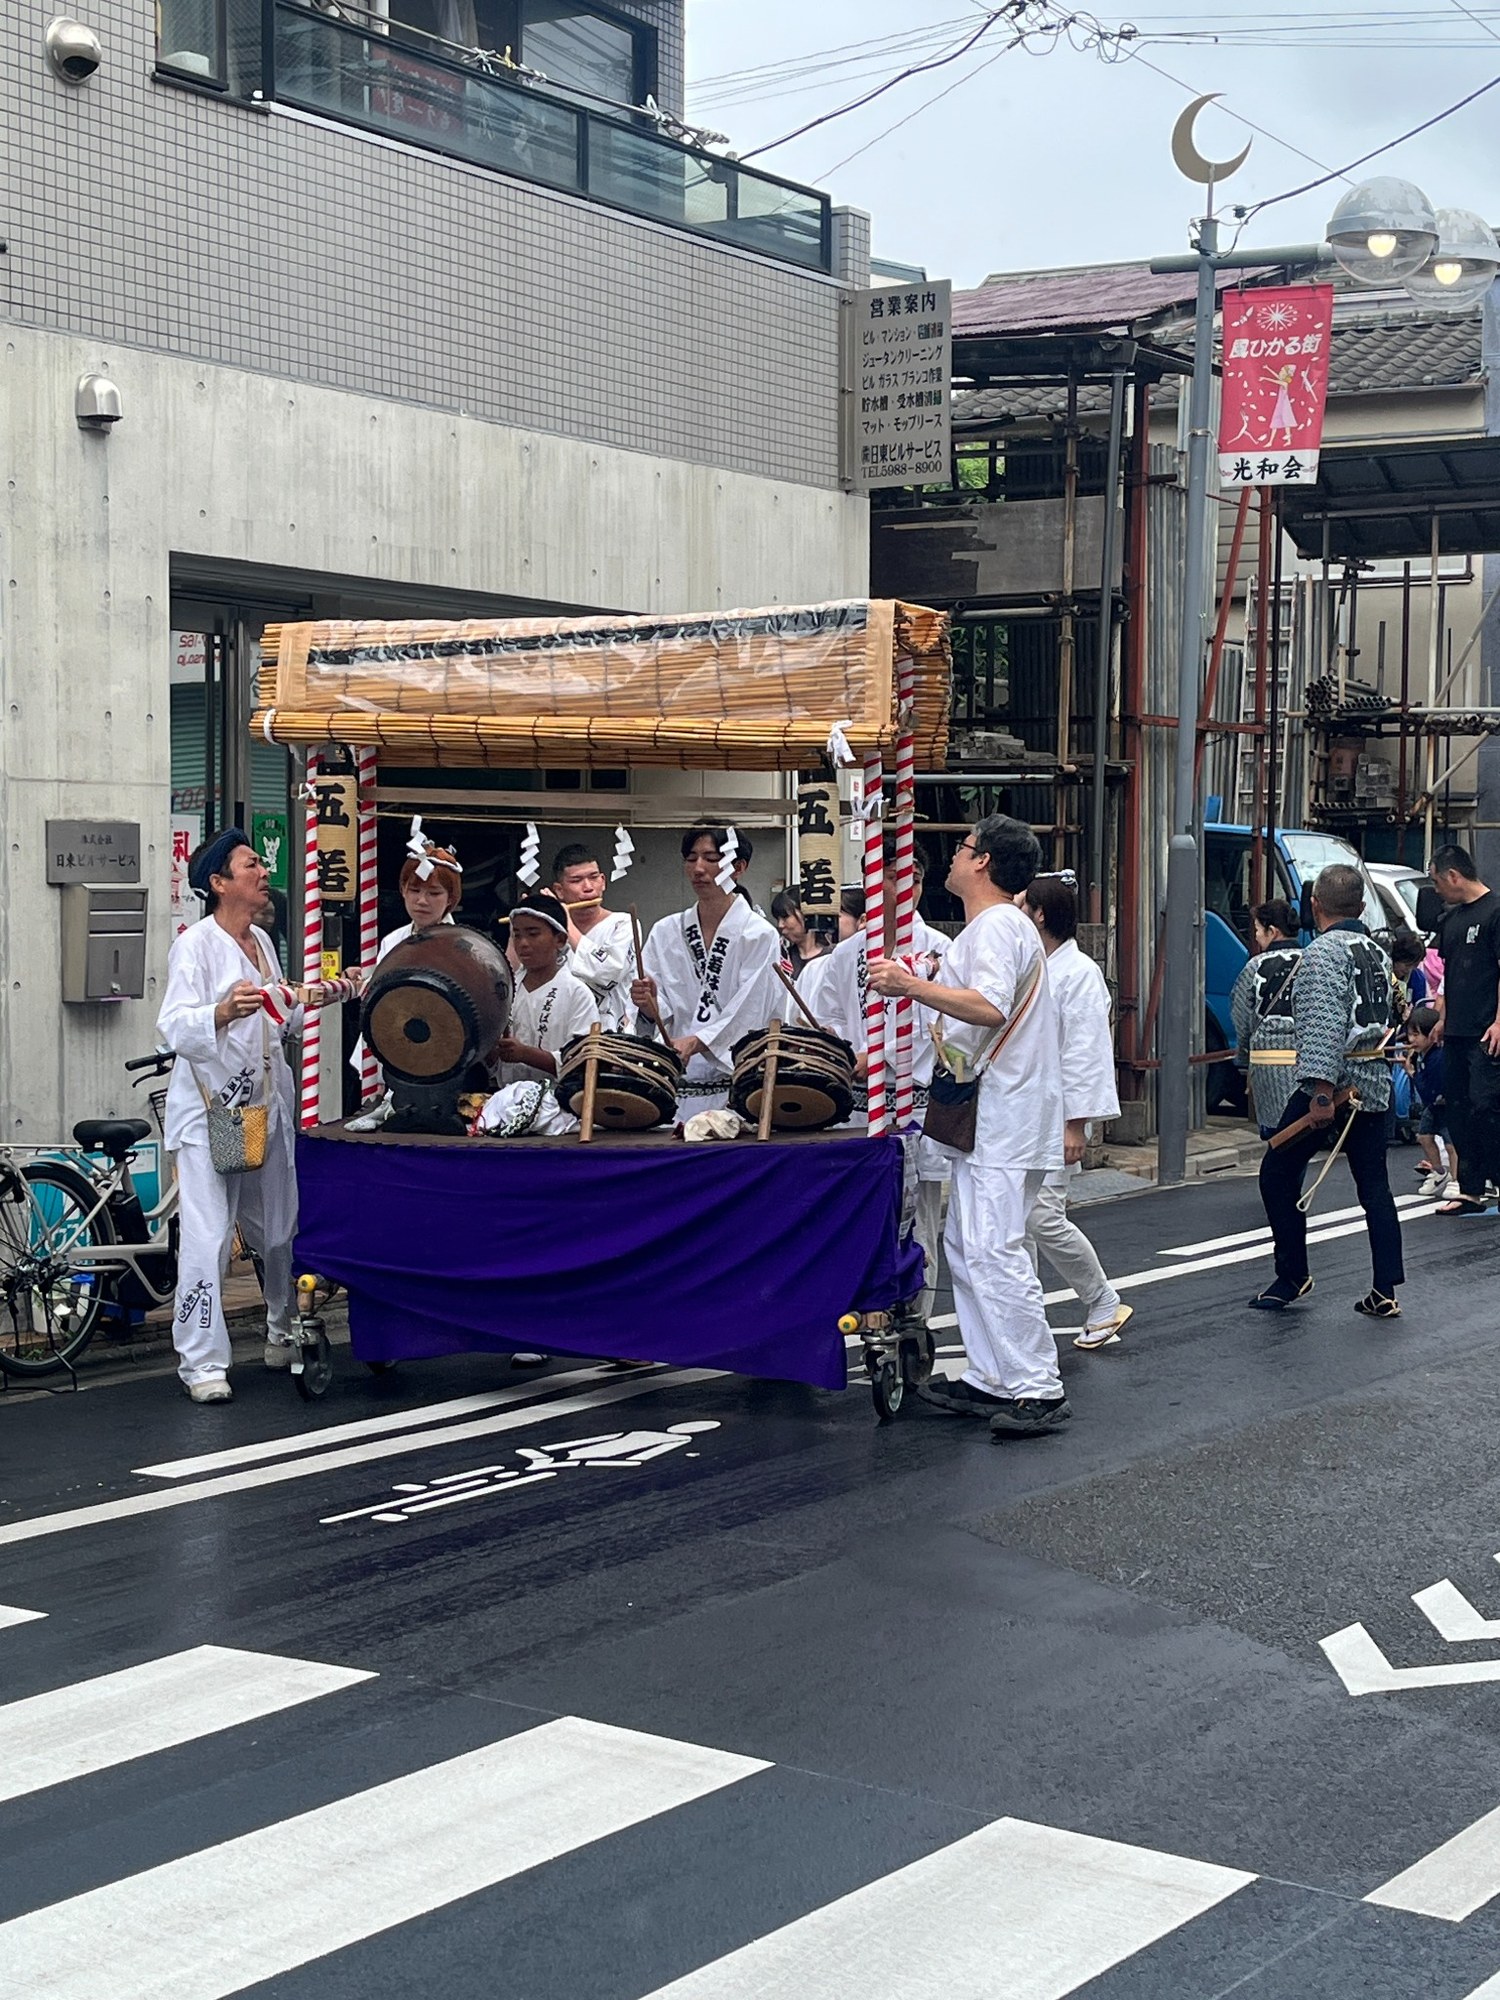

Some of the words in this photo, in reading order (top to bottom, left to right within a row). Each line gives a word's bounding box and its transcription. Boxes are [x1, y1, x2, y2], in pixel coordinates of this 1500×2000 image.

[870, 291, 936, 318] 営業案内
[862, 345, 943, 368] ジュータンクリーニング
[1229, 334, 1322, 359] 風ひかる街
[1232, 456, 1304, 481] 光和会
[798, 789, 836, 905] 五若
